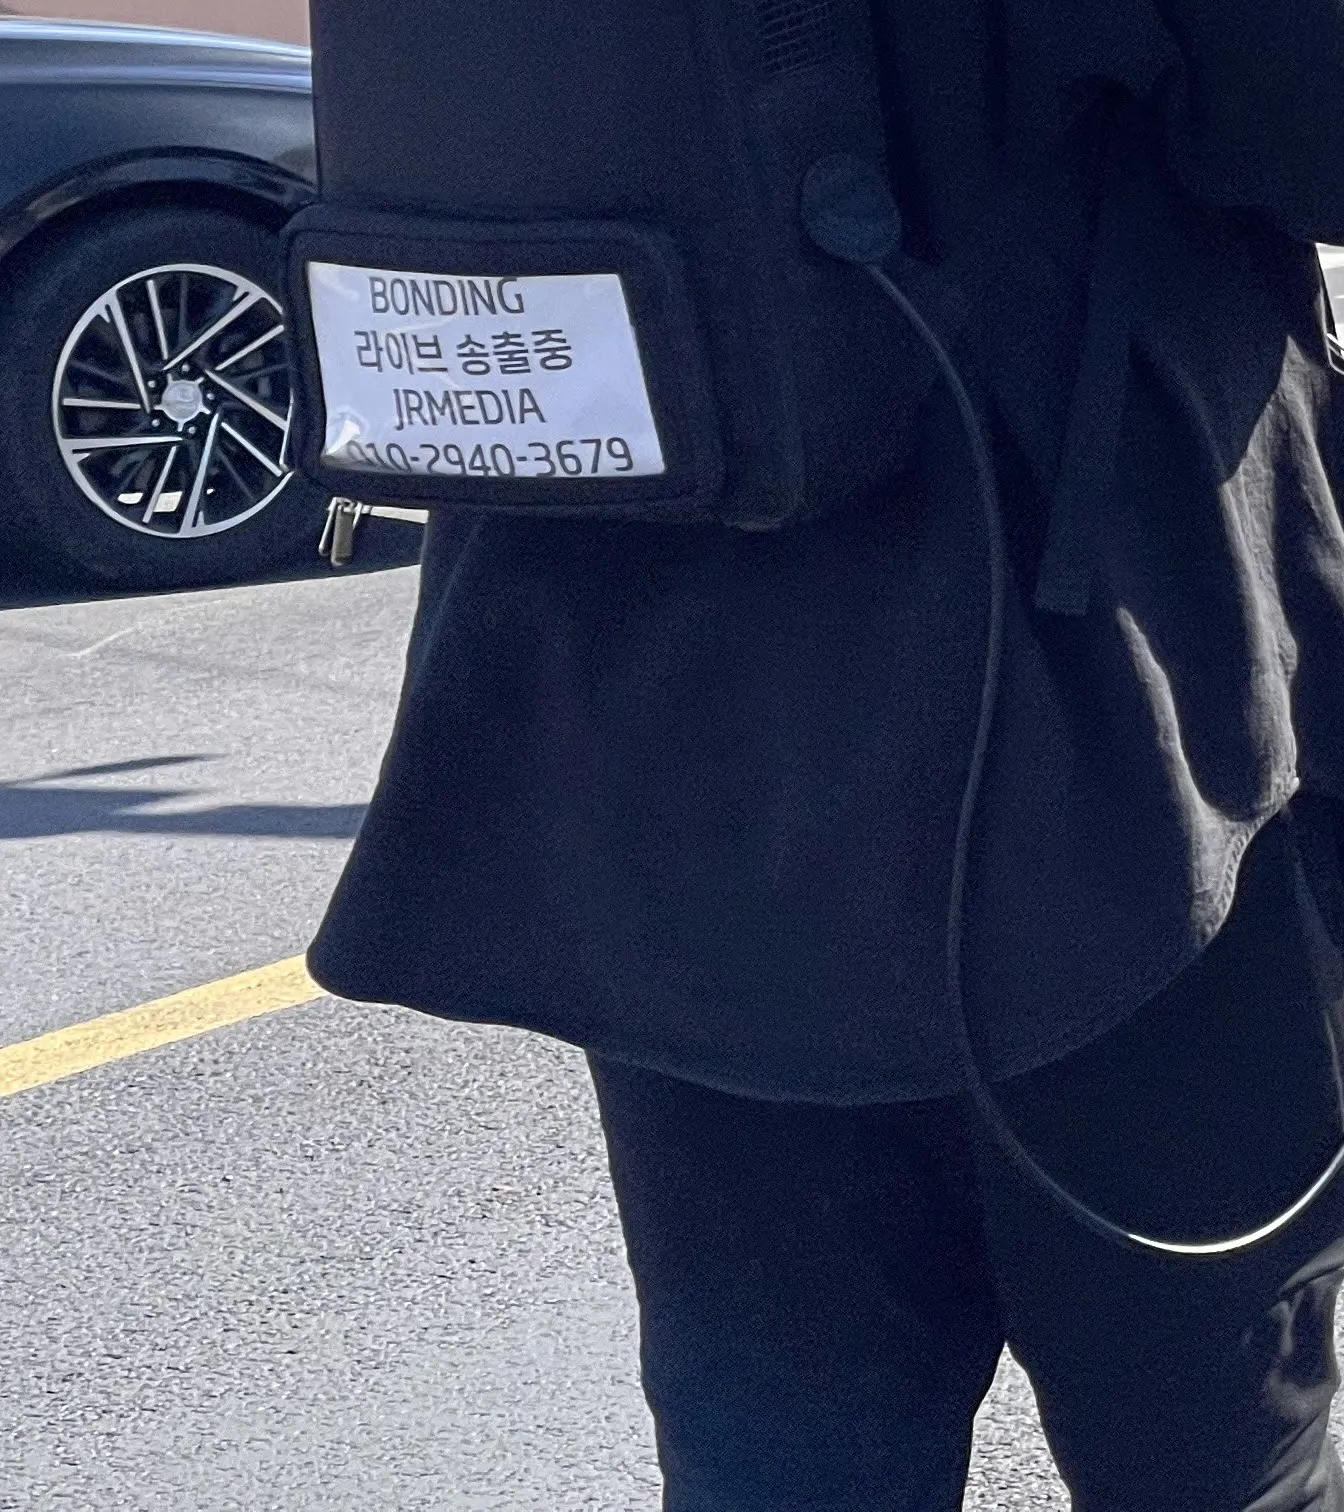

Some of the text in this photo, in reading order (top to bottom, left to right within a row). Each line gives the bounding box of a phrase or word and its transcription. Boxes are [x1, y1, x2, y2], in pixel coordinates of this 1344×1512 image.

[369, 276, 525, 316] BONDING
[354, 329, 573, 376] 라이브 송출중
[393, 388, 547, 431] JRMEDIA
